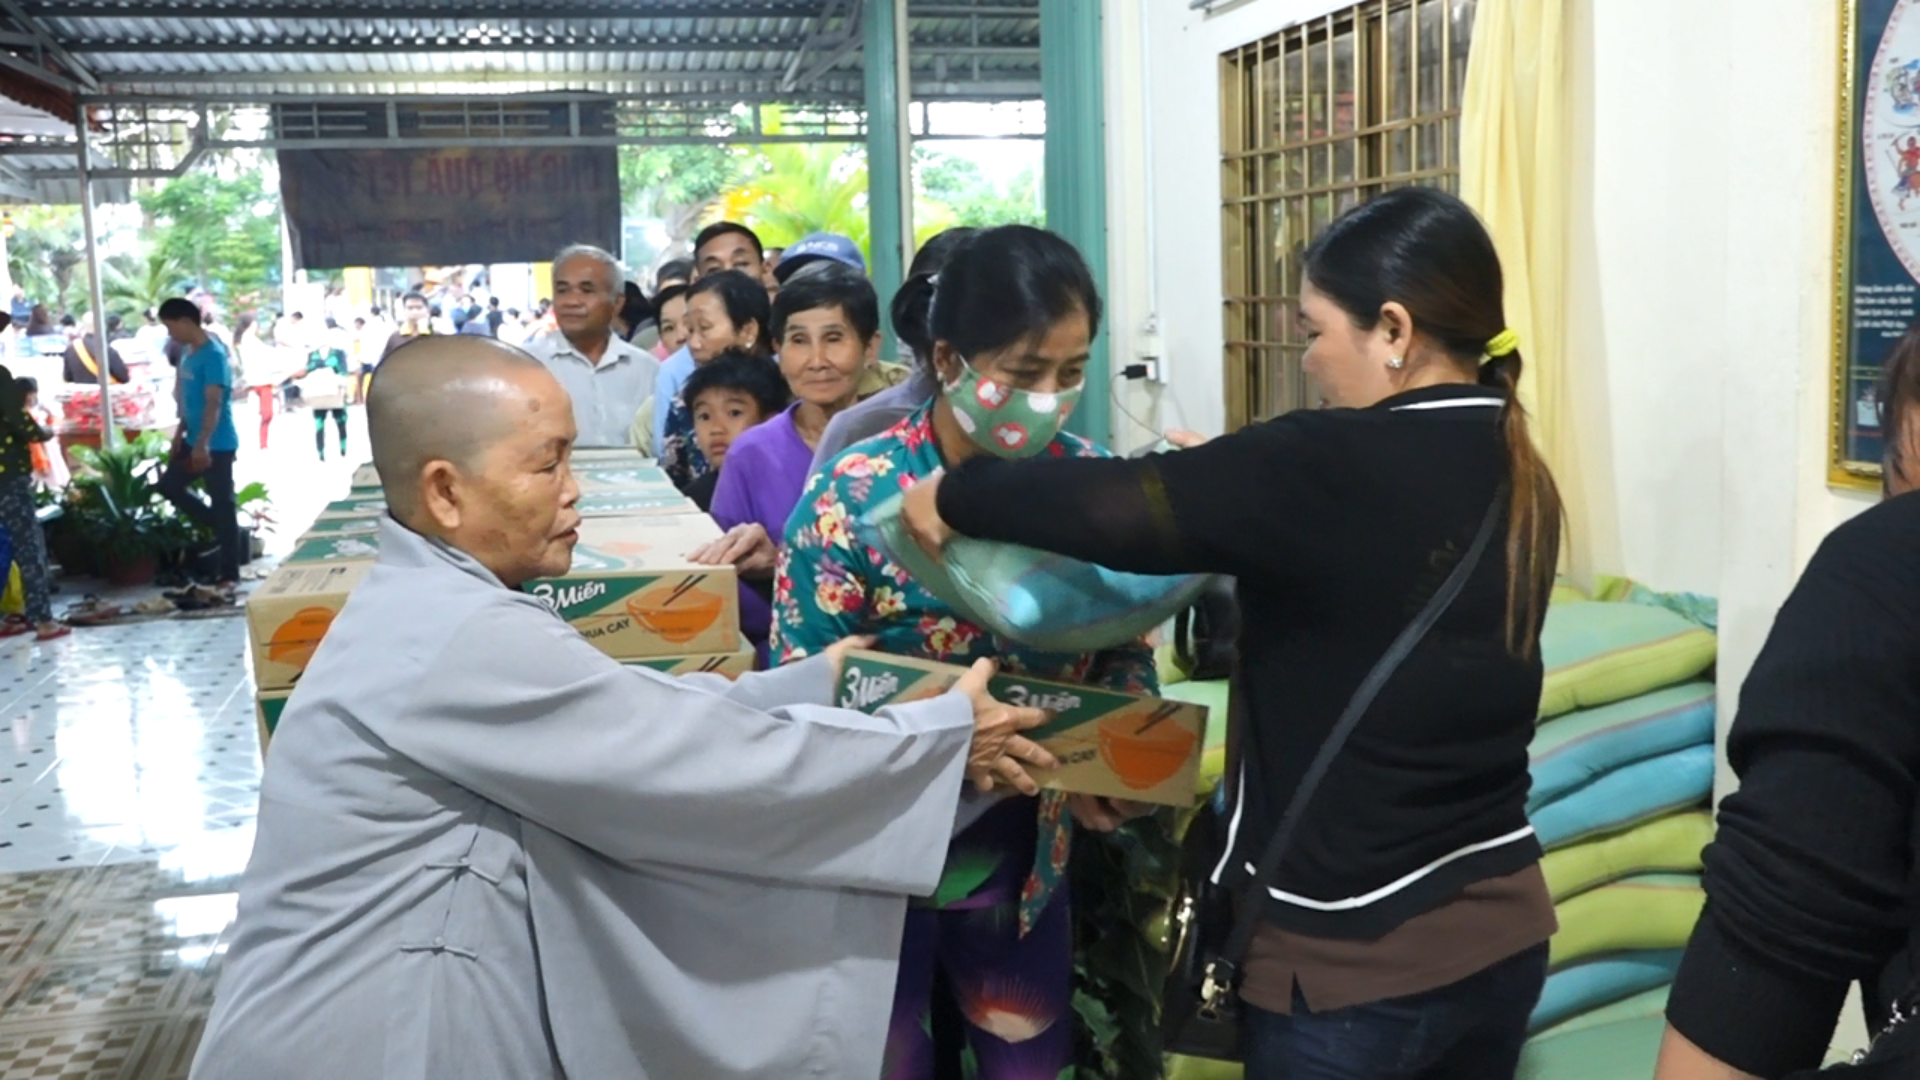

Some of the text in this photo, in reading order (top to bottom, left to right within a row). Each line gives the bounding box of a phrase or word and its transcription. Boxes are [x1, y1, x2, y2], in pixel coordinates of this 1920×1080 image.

[533, 583, 555, 609] 3
[606, 617, 630, 634] CAY
[841, 666, 861, 709] 3
